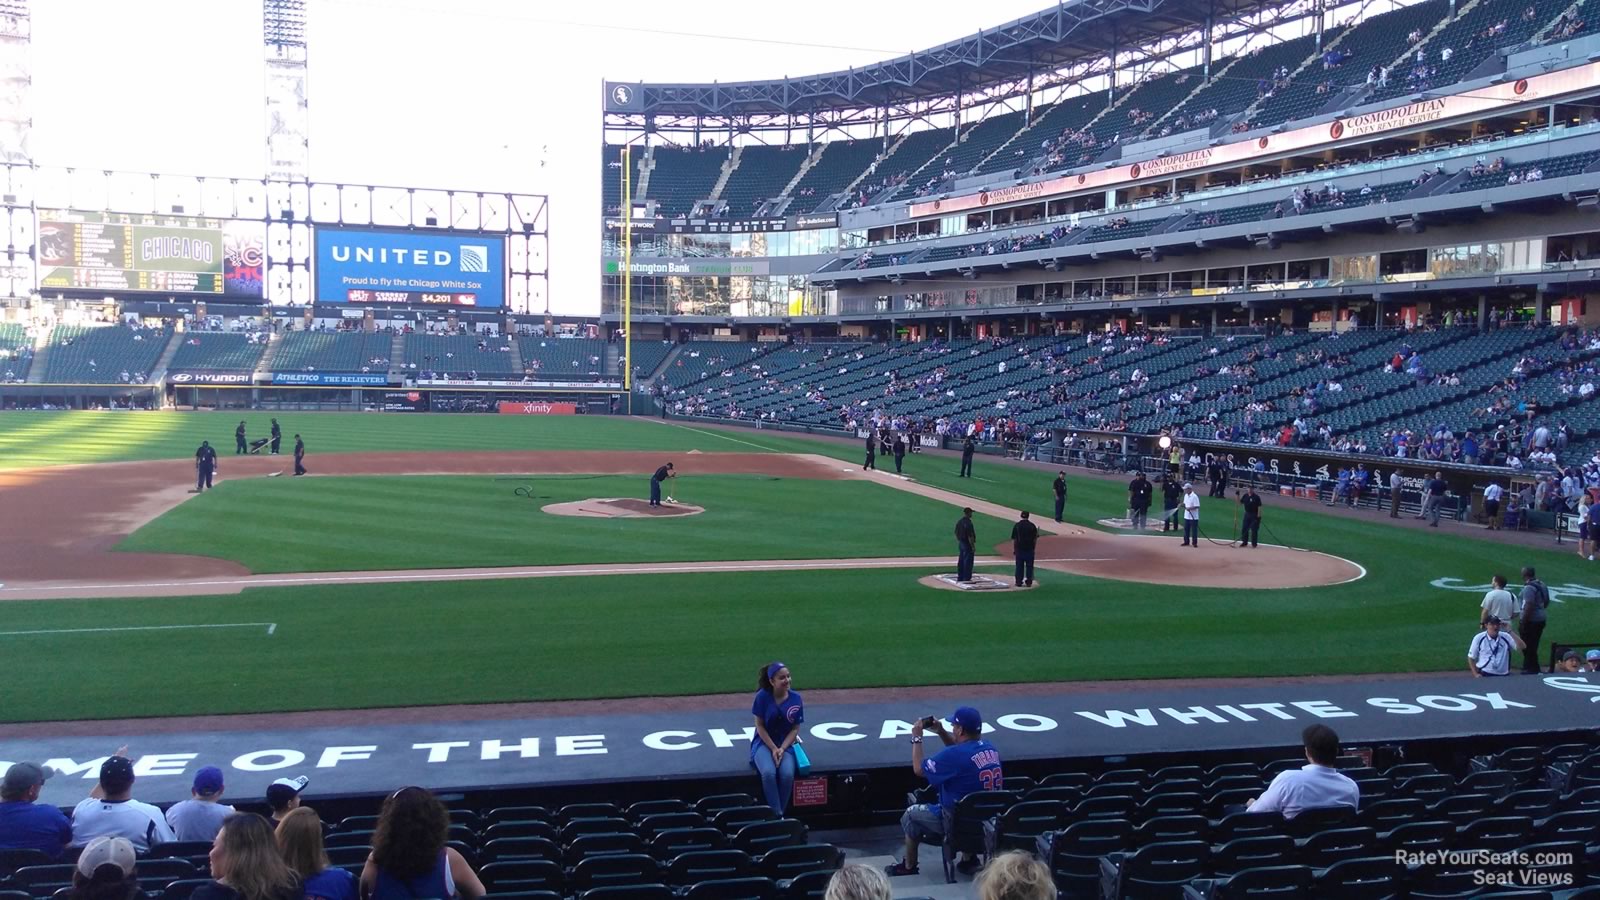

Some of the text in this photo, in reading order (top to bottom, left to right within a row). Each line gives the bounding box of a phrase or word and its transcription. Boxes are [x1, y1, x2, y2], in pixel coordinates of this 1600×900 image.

[1347, 98, 1446, 128] COSMOPOLITAN
[1352, 110, 1442, 136] LINEN RENTAL SERVICE
[1142, 150, 1212, 170] COSMOPOLITAN
[1186, 159, 1208, 168] SERVICE
[990, 182, 1044, 198] COSMOPOLITAN
[142, 236, 213, 264] CHICAGO
[332, 246, 451, 266] UNITED
[618, 262, 689, 274] Hntington Bank
[343, 276, 368, 284] Proud
[380, 278, 391, 287] fly
[409, 279, 440, 288] Chicago
[422, 294, 451, 302] $4,201
[524, 404, 551, 414] xfinity
[920, 435, 938, 447] Modelo
[232, 745, 378, 772] OF
[412, 734, 609, 762] THE
[642, 713, 1058, 750] CHCAO
[1074, 700, 1359, 728] WHITE
[1366, 692, 1536, 714] SOX
